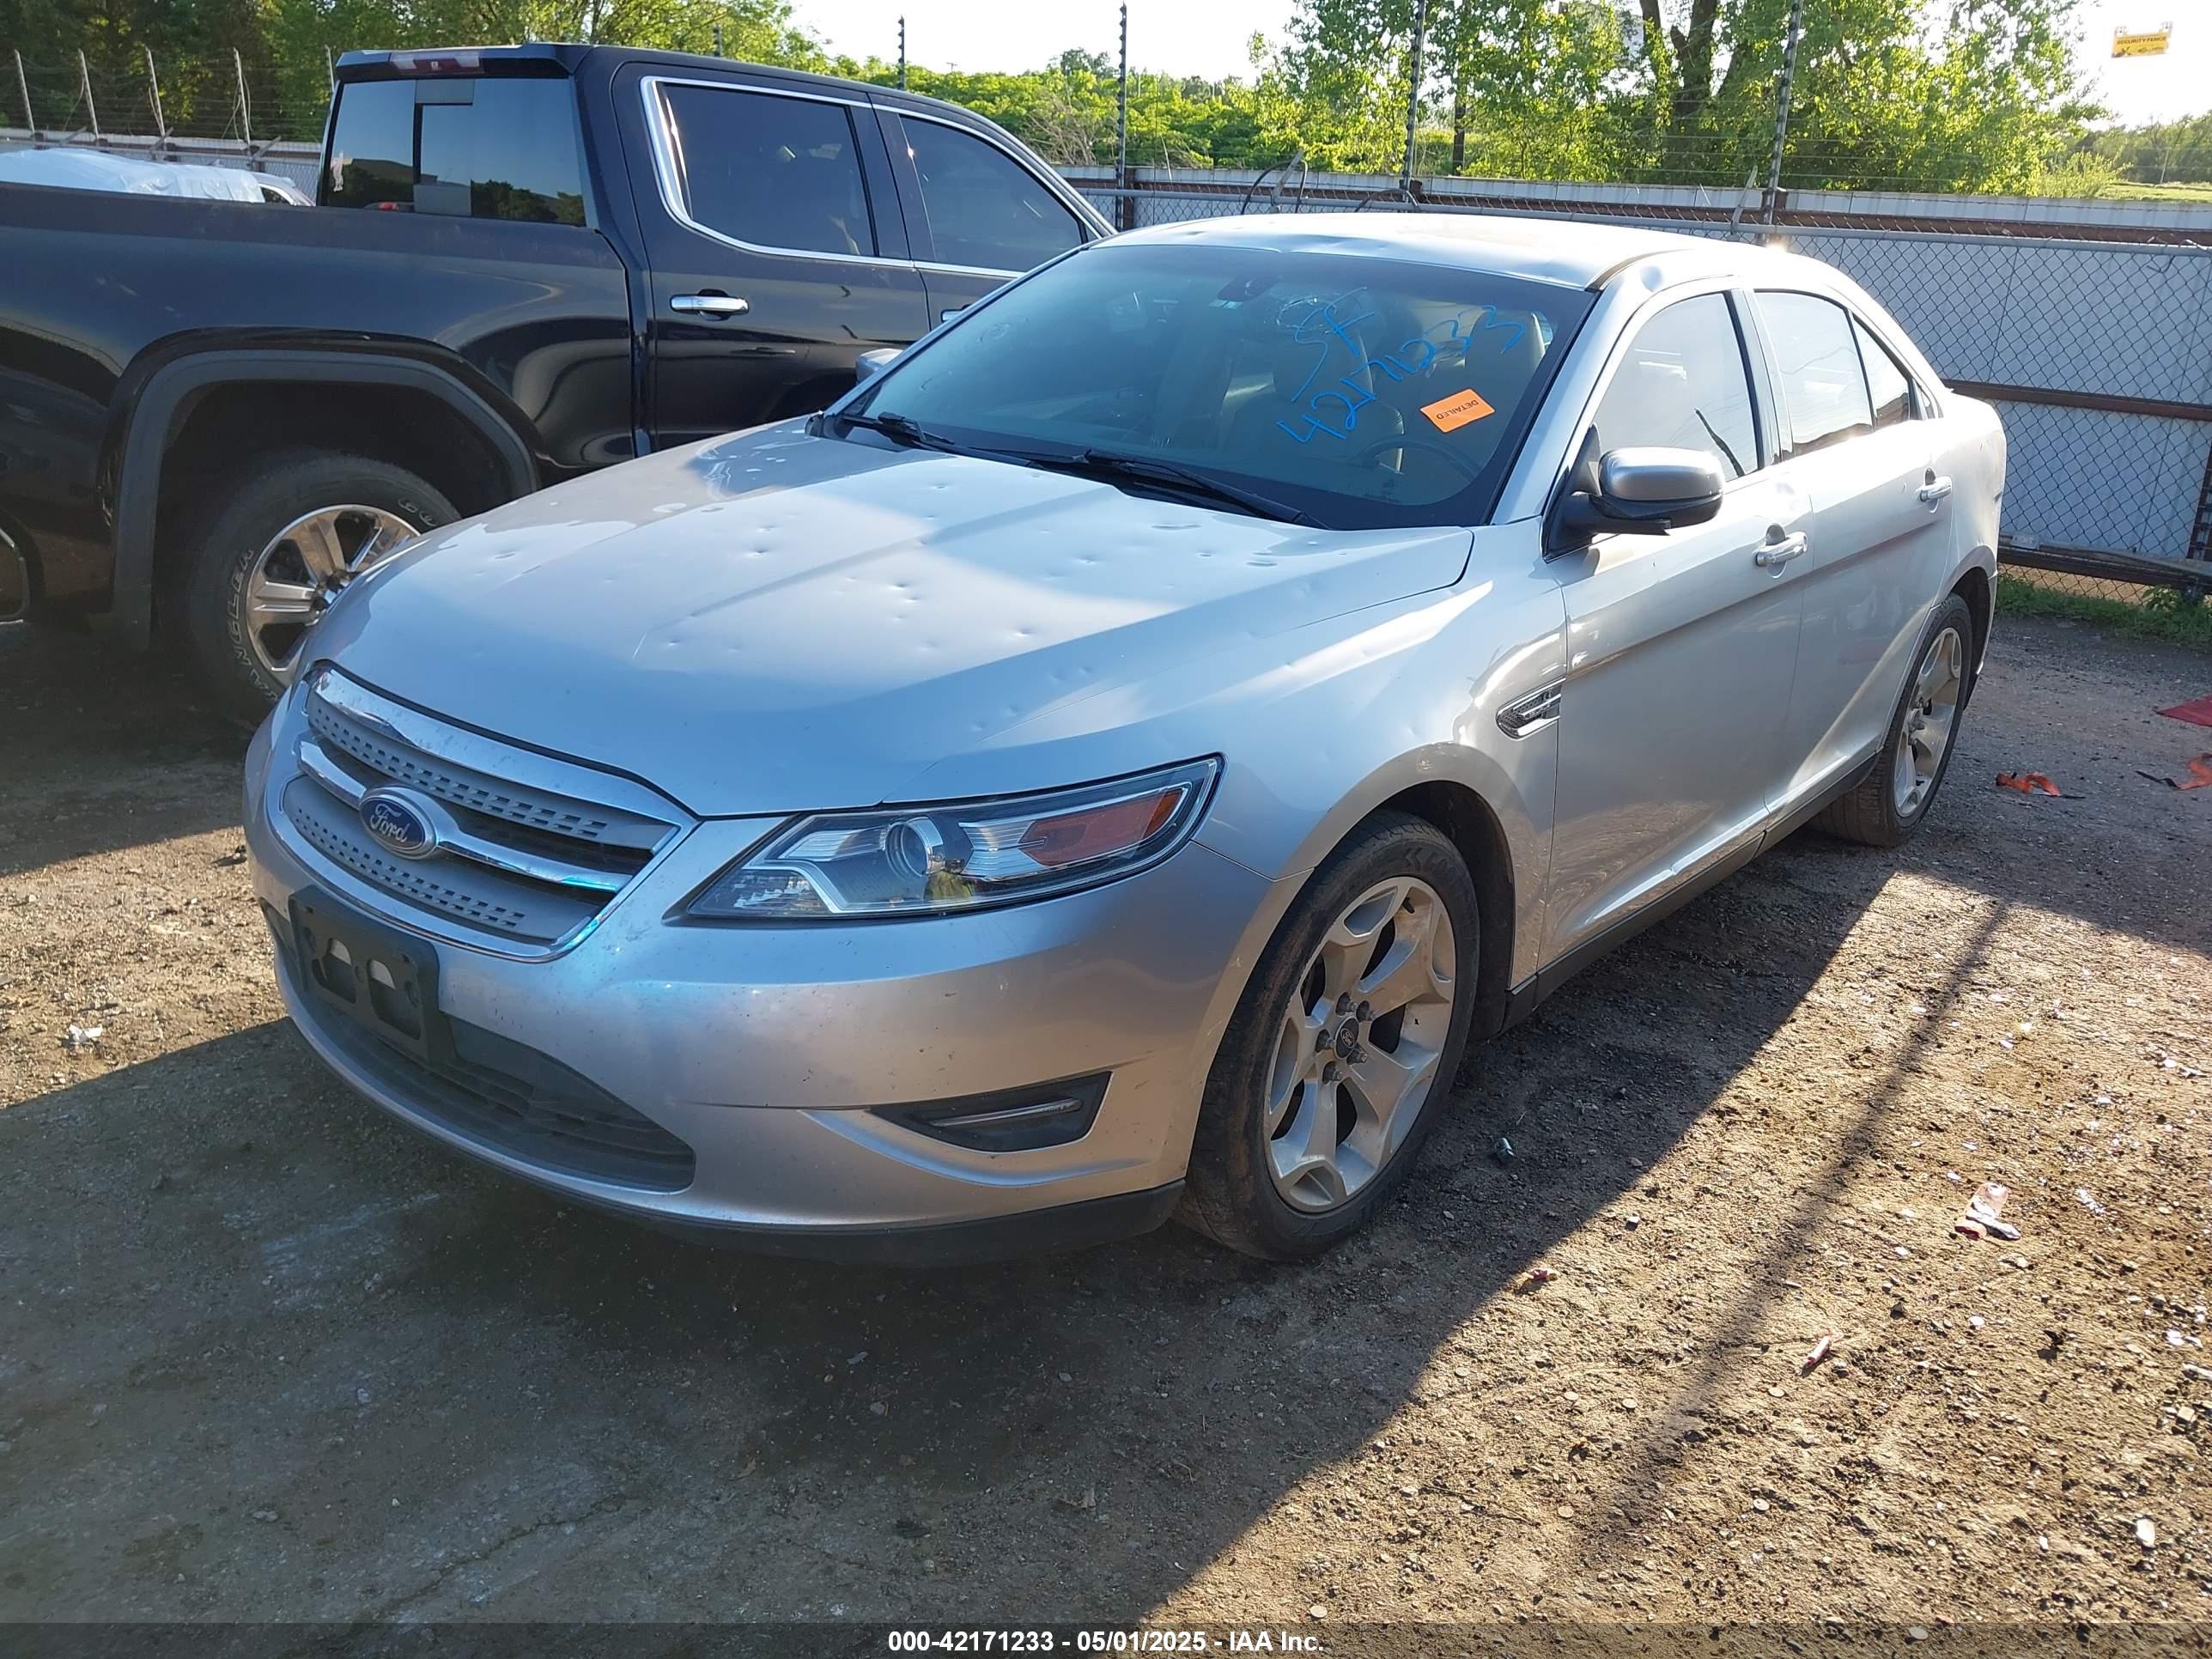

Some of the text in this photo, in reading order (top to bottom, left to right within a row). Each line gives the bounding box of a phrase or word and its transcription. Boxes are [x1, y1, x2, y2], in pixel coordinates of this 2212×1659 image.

[1276, 305, 1526, 443] 42171233
[1436, 399, 1479, 419] DETAILED
[370, 804, 410, 842] Ford
